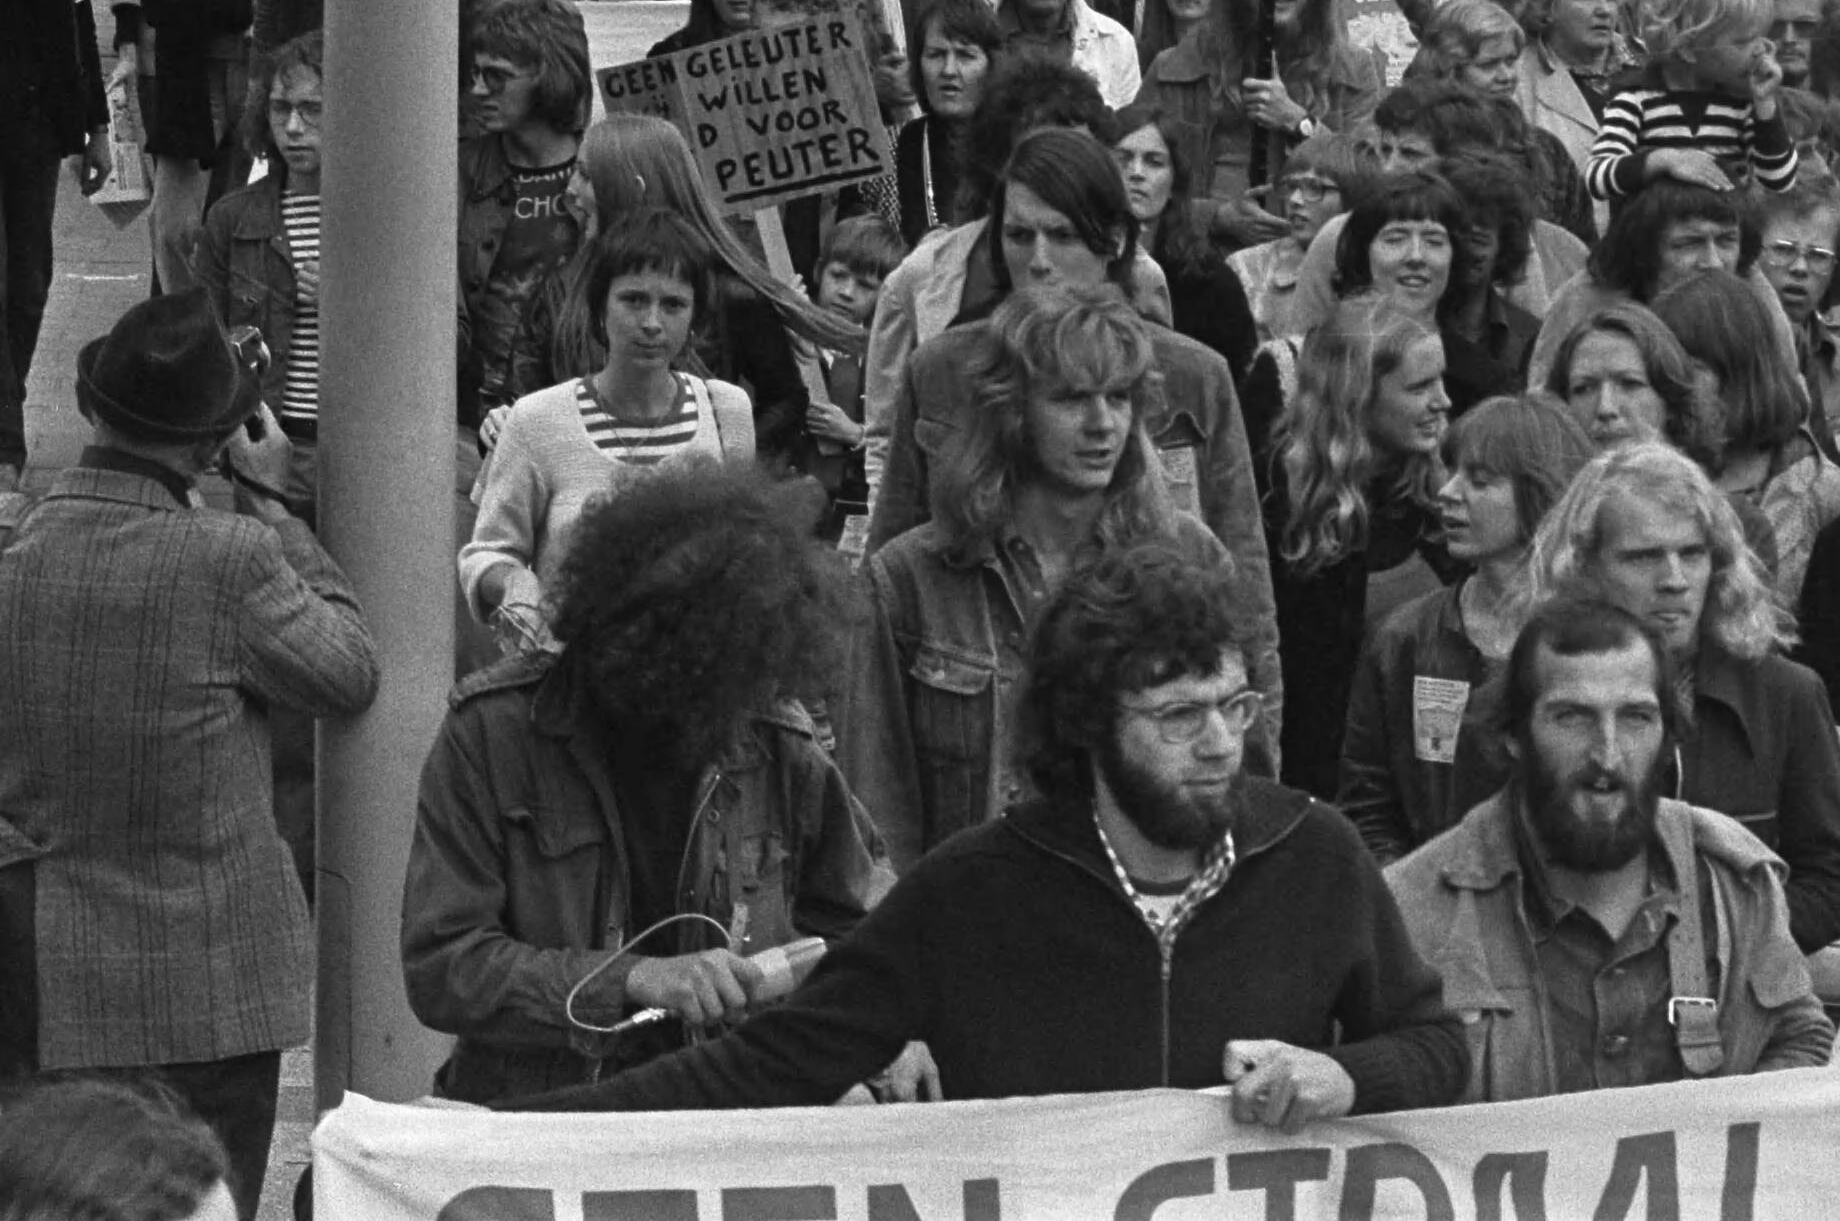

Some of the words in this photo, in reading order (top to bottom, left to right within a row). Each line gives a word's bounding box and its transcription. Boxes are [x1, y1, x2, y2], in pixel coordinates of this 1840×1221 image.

[604, 57, 678, 99] GEEN
[686, 21, 852, 79] GELEUTER
[746, 100, 848, 137] VOOR
[715, 127, 880, 192] PEUTER
